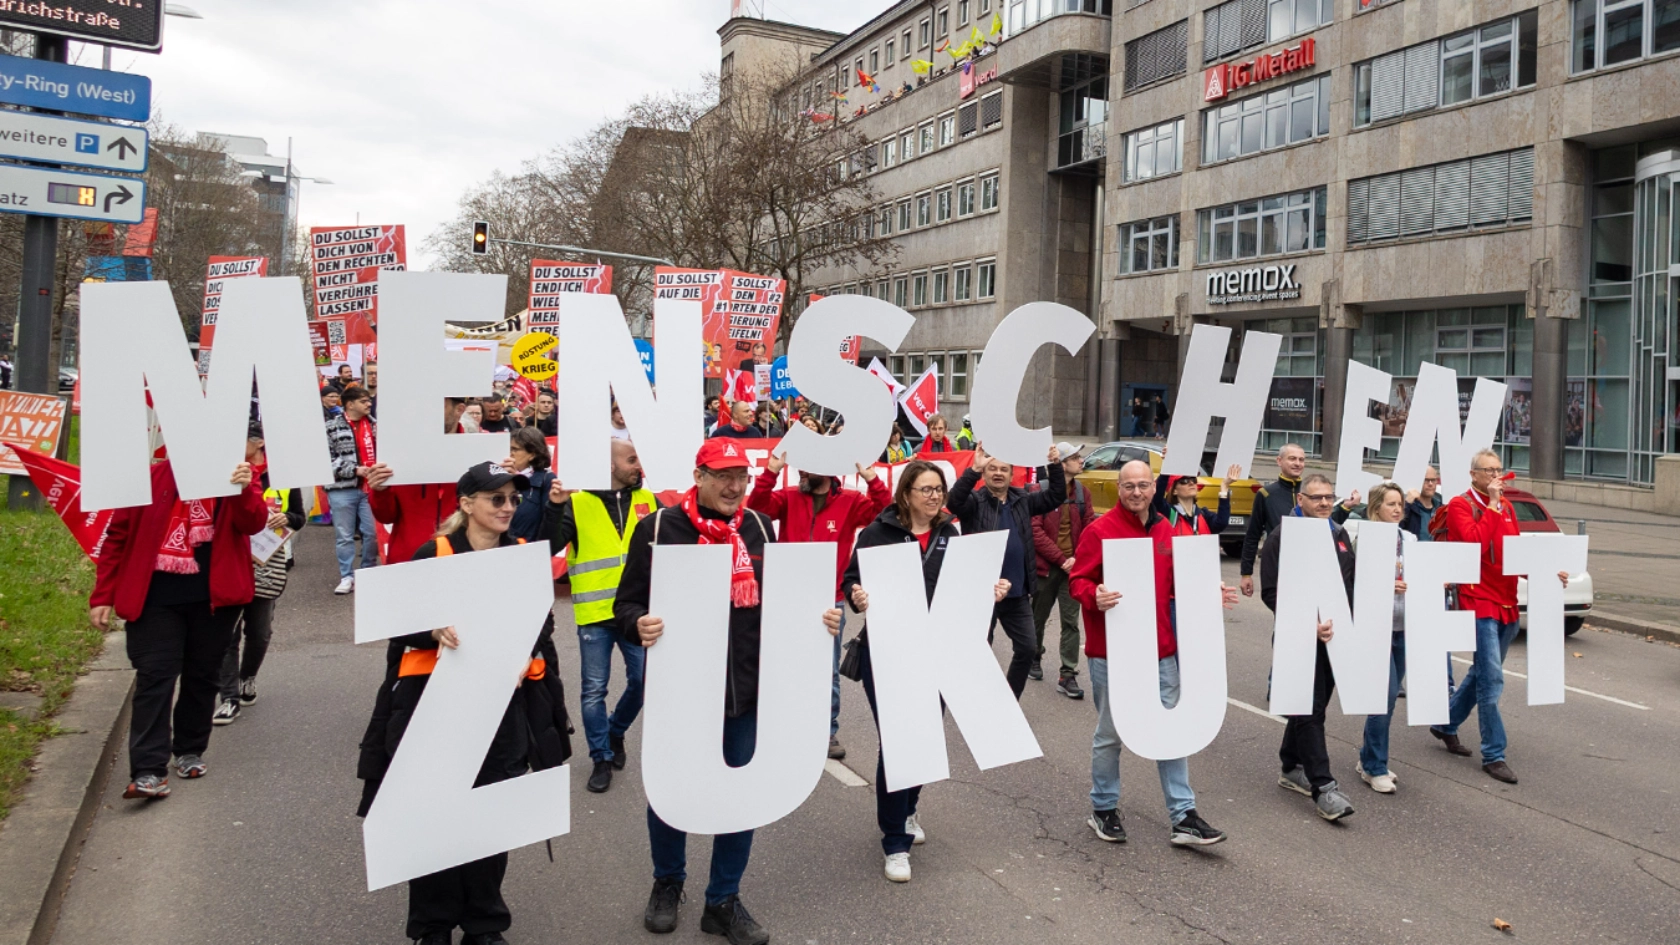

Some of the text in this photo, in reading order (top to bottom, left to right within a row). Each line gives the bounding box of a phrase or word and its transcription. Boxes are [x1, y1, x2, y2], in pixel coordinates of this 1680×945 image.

[1229, 38, 1315, 89] IG Metall
[77, 81, 136, 105] (West)
[315, 227, 379, 244] DU SOLLST
[317, 242, 373, 258] DICH VON
[209, 261, 256, 276] DU SOLLST
[317, 253, 394, 273] DEN RECHTEN
[319, 272, 355, 287] NICHT
[534, 267, 597, 278] DU SOLLST
[658, 273, 717, 284] DU SOLLST
[534, 282, 583, 293] ENDLICH
[737, 278, 773, 289] SOLLST
[658, 288, 700, 299] AUF DIE
[735, 290, 755, 300] DEN
[768, 294, 782, 303] #2
[320, 298, 369, 315] LASSEN!
[715, 302, 728, 312] #1
[731, 304, 778, 314] RTEN DER
[518, 337, 555, 361] RÜSTUNG
[522, 362, 556, 374] KRIEG
[80, 270, 1509, 513] MENSCHEN
[354, 516, 1589, 891] ZUKUNFT
